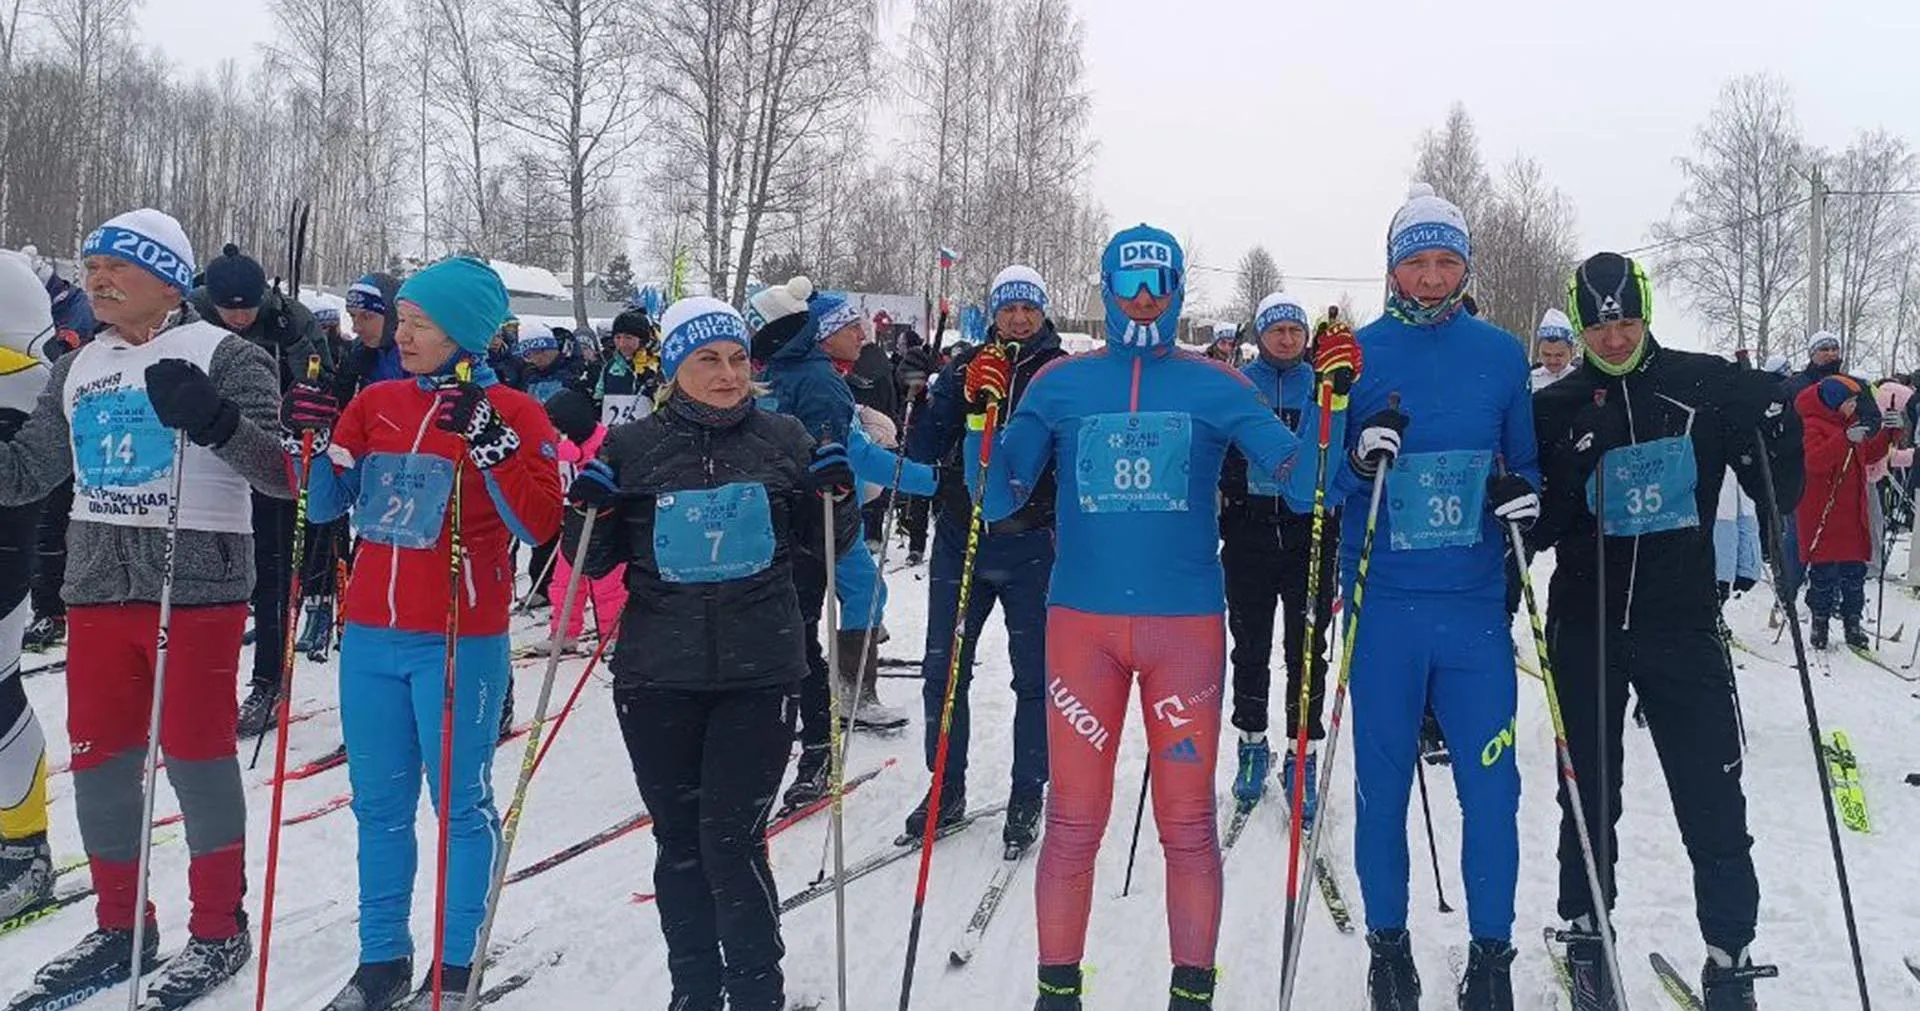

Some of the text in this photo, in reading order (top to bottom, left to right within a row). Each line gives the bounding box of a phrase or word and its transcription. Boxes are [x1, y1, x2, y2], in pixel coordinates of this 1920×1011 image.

[1124, 245, 1168, 262] DKB
[100, 432, 135, 465] 14
[1114, 457, 1151, 490] 88
[297, 488, 308, 529] LEKI
[380, 495, 415, 526] 21
[1312, 488, 1325, 540] LEKI
[1427, 495, 1463, 528] 36
[1626, 483, 1663, 514] 35
[450, 533, 460, 573] LEKI
[704, 531, 724, 561] 7
[1049, 676, 1109, 752] LUKOIL
